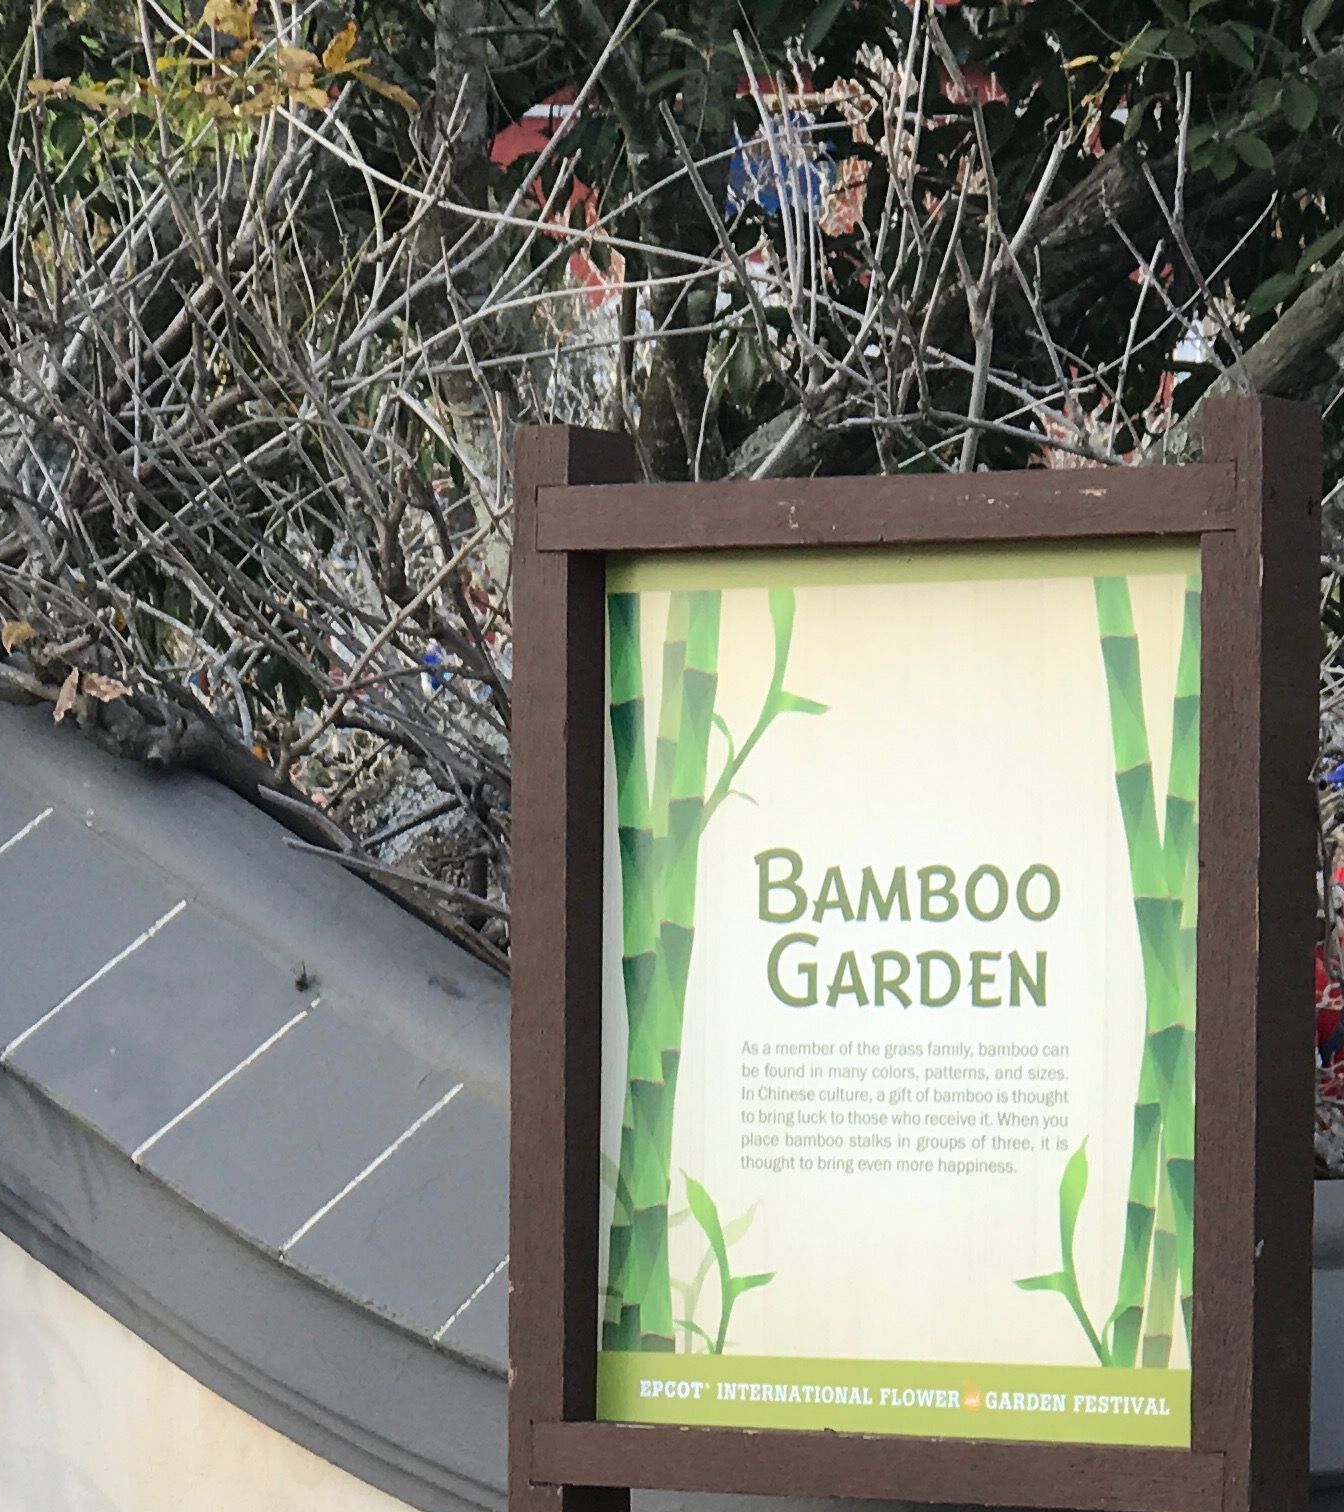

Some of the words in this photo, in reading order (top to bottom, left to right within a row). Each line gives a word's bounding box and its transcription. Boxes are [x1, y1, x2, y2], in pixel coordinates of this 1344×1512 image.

[742, 1041, 759, 1054] As
[762, 1042, 771, 1054] a
[776, 1041, 836, 1055] member
[839, 1042, 854, 1055] of
[857, 1042, 881, 1055] the
[884, 1044, 923, 1058] grass
[927, 1042, 974, 1059] family,
[978, 1043, 1039, 1057] bamboo
[1042, 1045, 1069, 1057] can
[742, 1064, 760, 1078] be
[764, 1064, 805, 1078] found
[811, 1066, 823, 1078] in
[828, 1067, 867, 1081] many
[871, 1065, 919, 1081] colors,
[925, 1067, 989, 1082] patterns,
[995, 1066, 1023, 1080] and
[1028, 1068, 1069, 1080] sizes.
[741, 1087, 755, 1100] In
[758, 1087, 815, 1100] Chinese
[819, 1087, 873, 1103] culture,
[876, 1090, 885, 1101] a
[888, 1088, 913, 1104] gift
[915, 1088, 930, 1102] of
[933, 1089, 993, 1102] bamboo
[997, 1090, 1008, 1103] is
[1012, 1090, 1069, 1106] thought
[741, 1111, 755, 1123] to
[758, 1110, 795, 1127] bring
[798, 1111, 827, 1124] luck
[830, 1112, 845, 1124] to
[848, 1111, 888, 1125] those
[891, 1112, 921, 1125] who
[925, 1113, 976, 1126] receive
[981, 1114, 993, 1126] it.
[997, 1113, 1039, 1126] When
[1042, 1115, 1069, 1130] you
[741, 1134, 779, 1150] place
[785, 1134, 844, 1148] bamboo
[849, 1135, 892, 1148] stalks
[898, 1136, 910, 1149] in
[916, 1137, 966, 1152] groups
[972, 1136, 987, 1149] of
[992, 1136, 1035, 1152] three,
[1041, 1137, 1050, 1150] it
[1056, 1138, 1068, 1150] is
[741, 1156, 795, 1173] thought
[799, 1158, 814, 1170] to
[817, 1157, 854, 1173] bring
[857, 1159, 892, 1171] even
[896, 1160, 934, 1172] more
[938, 1159, 1018, 1176] happiness.
[716, 1381, 873, 1406] INTERNATIONAL
[879, 1387, 960, 1409] FLOWER
[985, 1391, 1065, 1413] GARDEN
[1073, 1394, 1170, 1416] FESTIVAL
